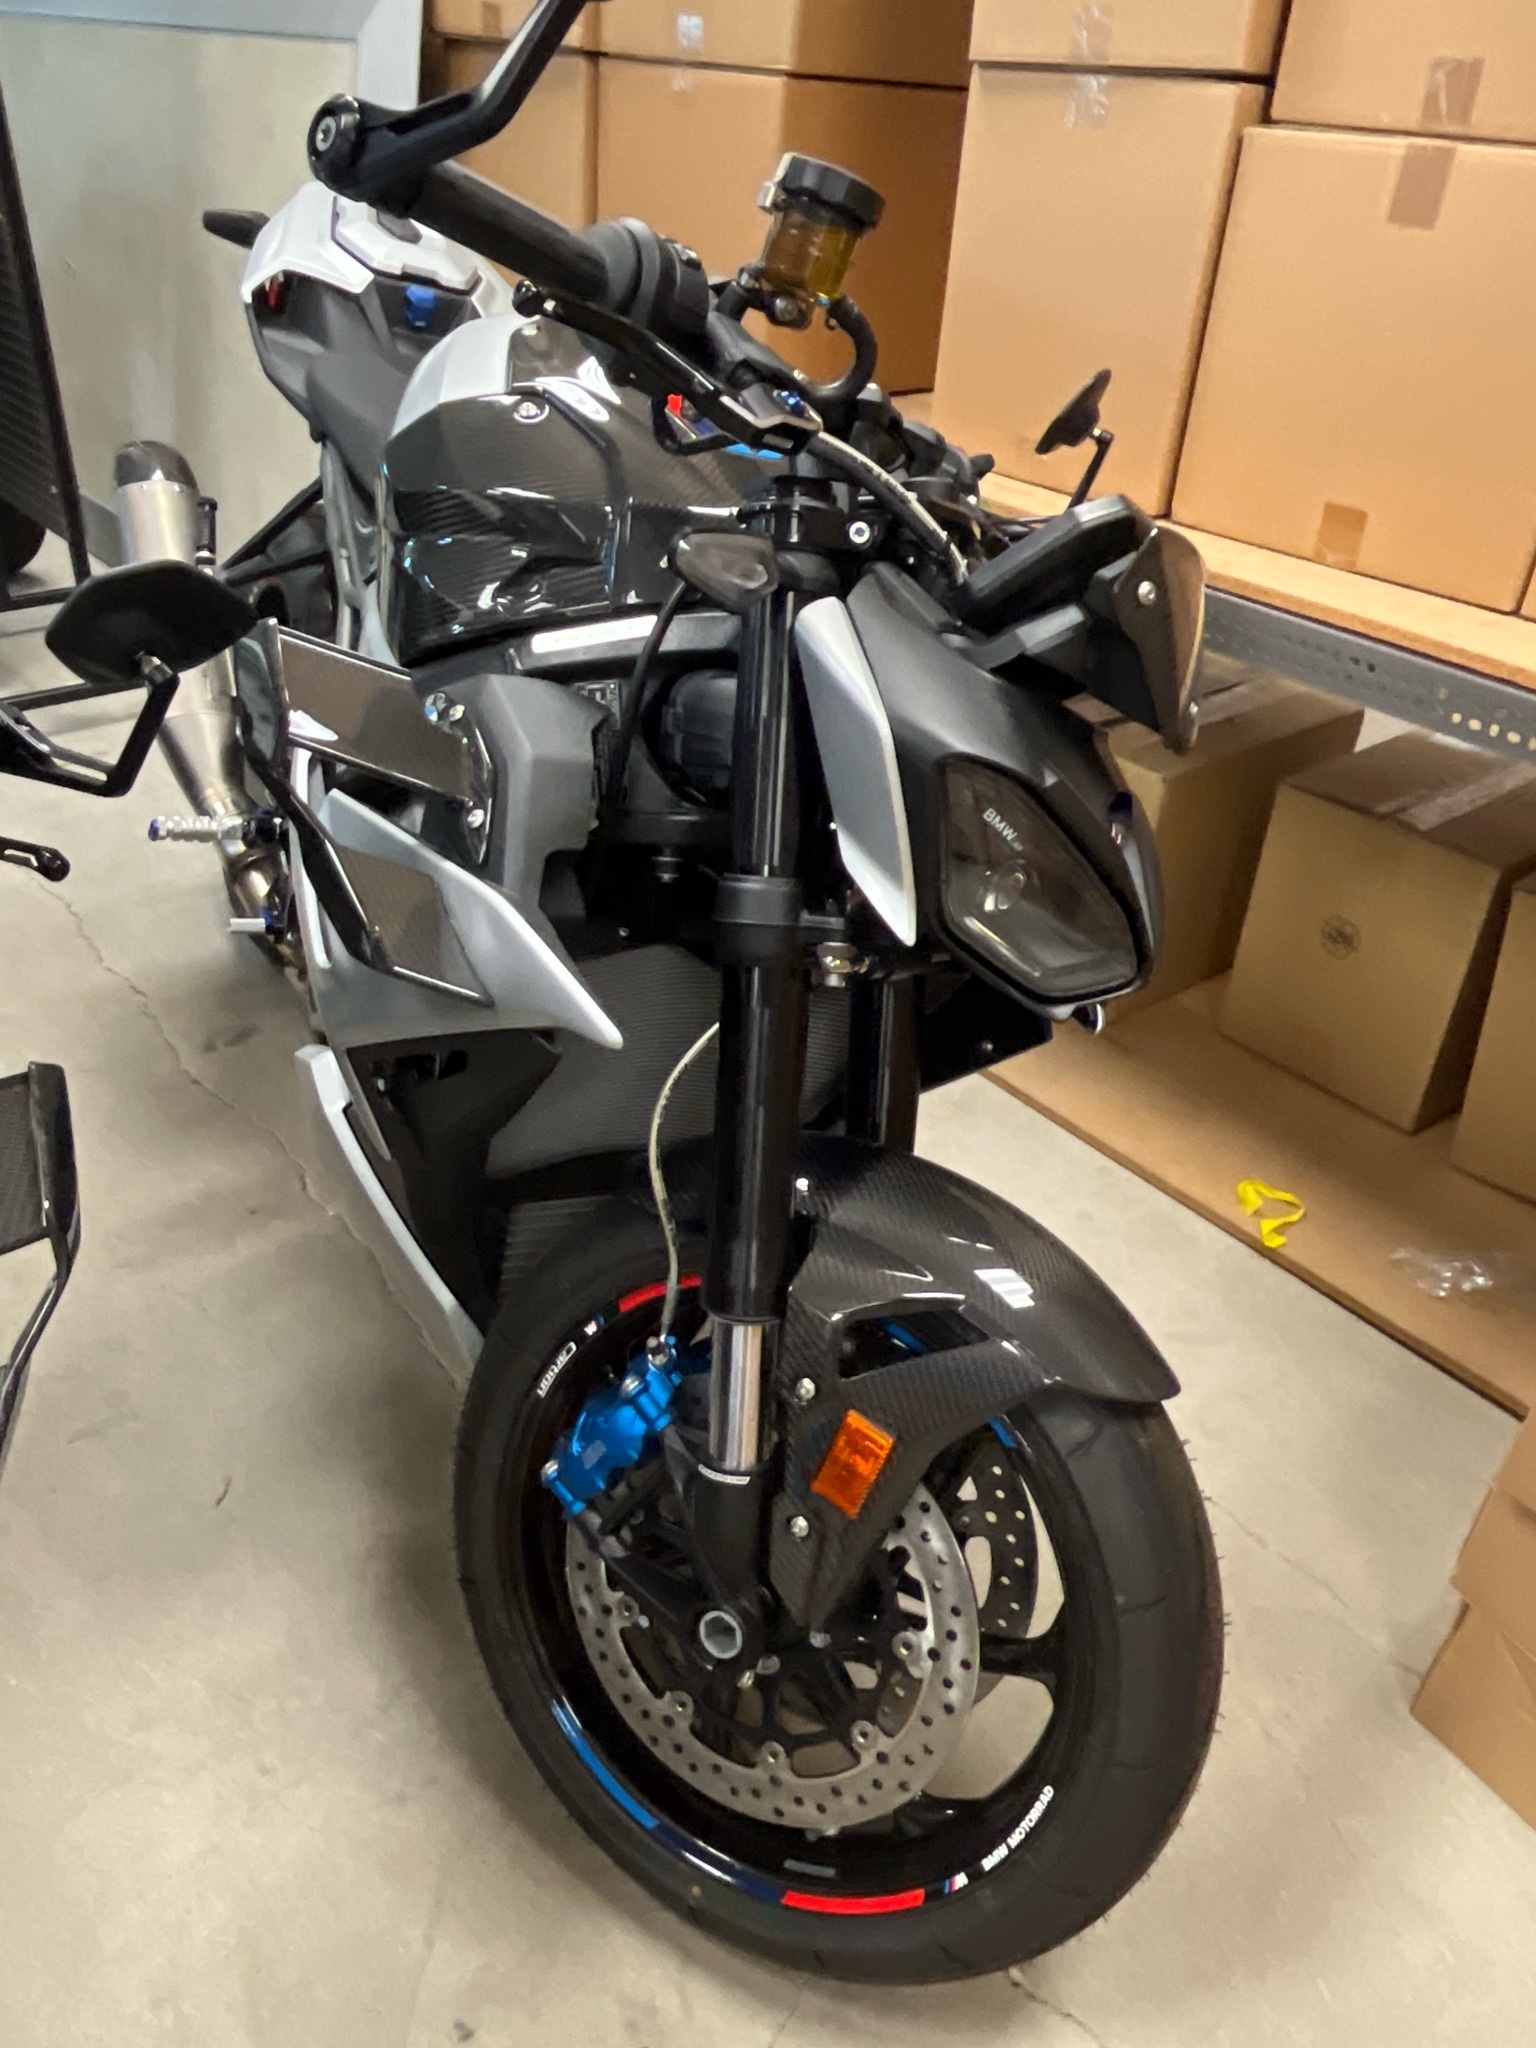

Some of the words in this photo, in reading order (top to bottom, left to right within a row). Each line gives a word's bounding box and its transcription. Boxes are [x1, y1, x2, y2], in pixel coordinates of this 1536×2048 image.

[982, 808, 1018, 841] BMW
[536, 1341, 577, 1398] Carbon
[981, 1842, 1009, 1872] BMW
[1006, 1785, 1054, 1849] MOTORRAD
